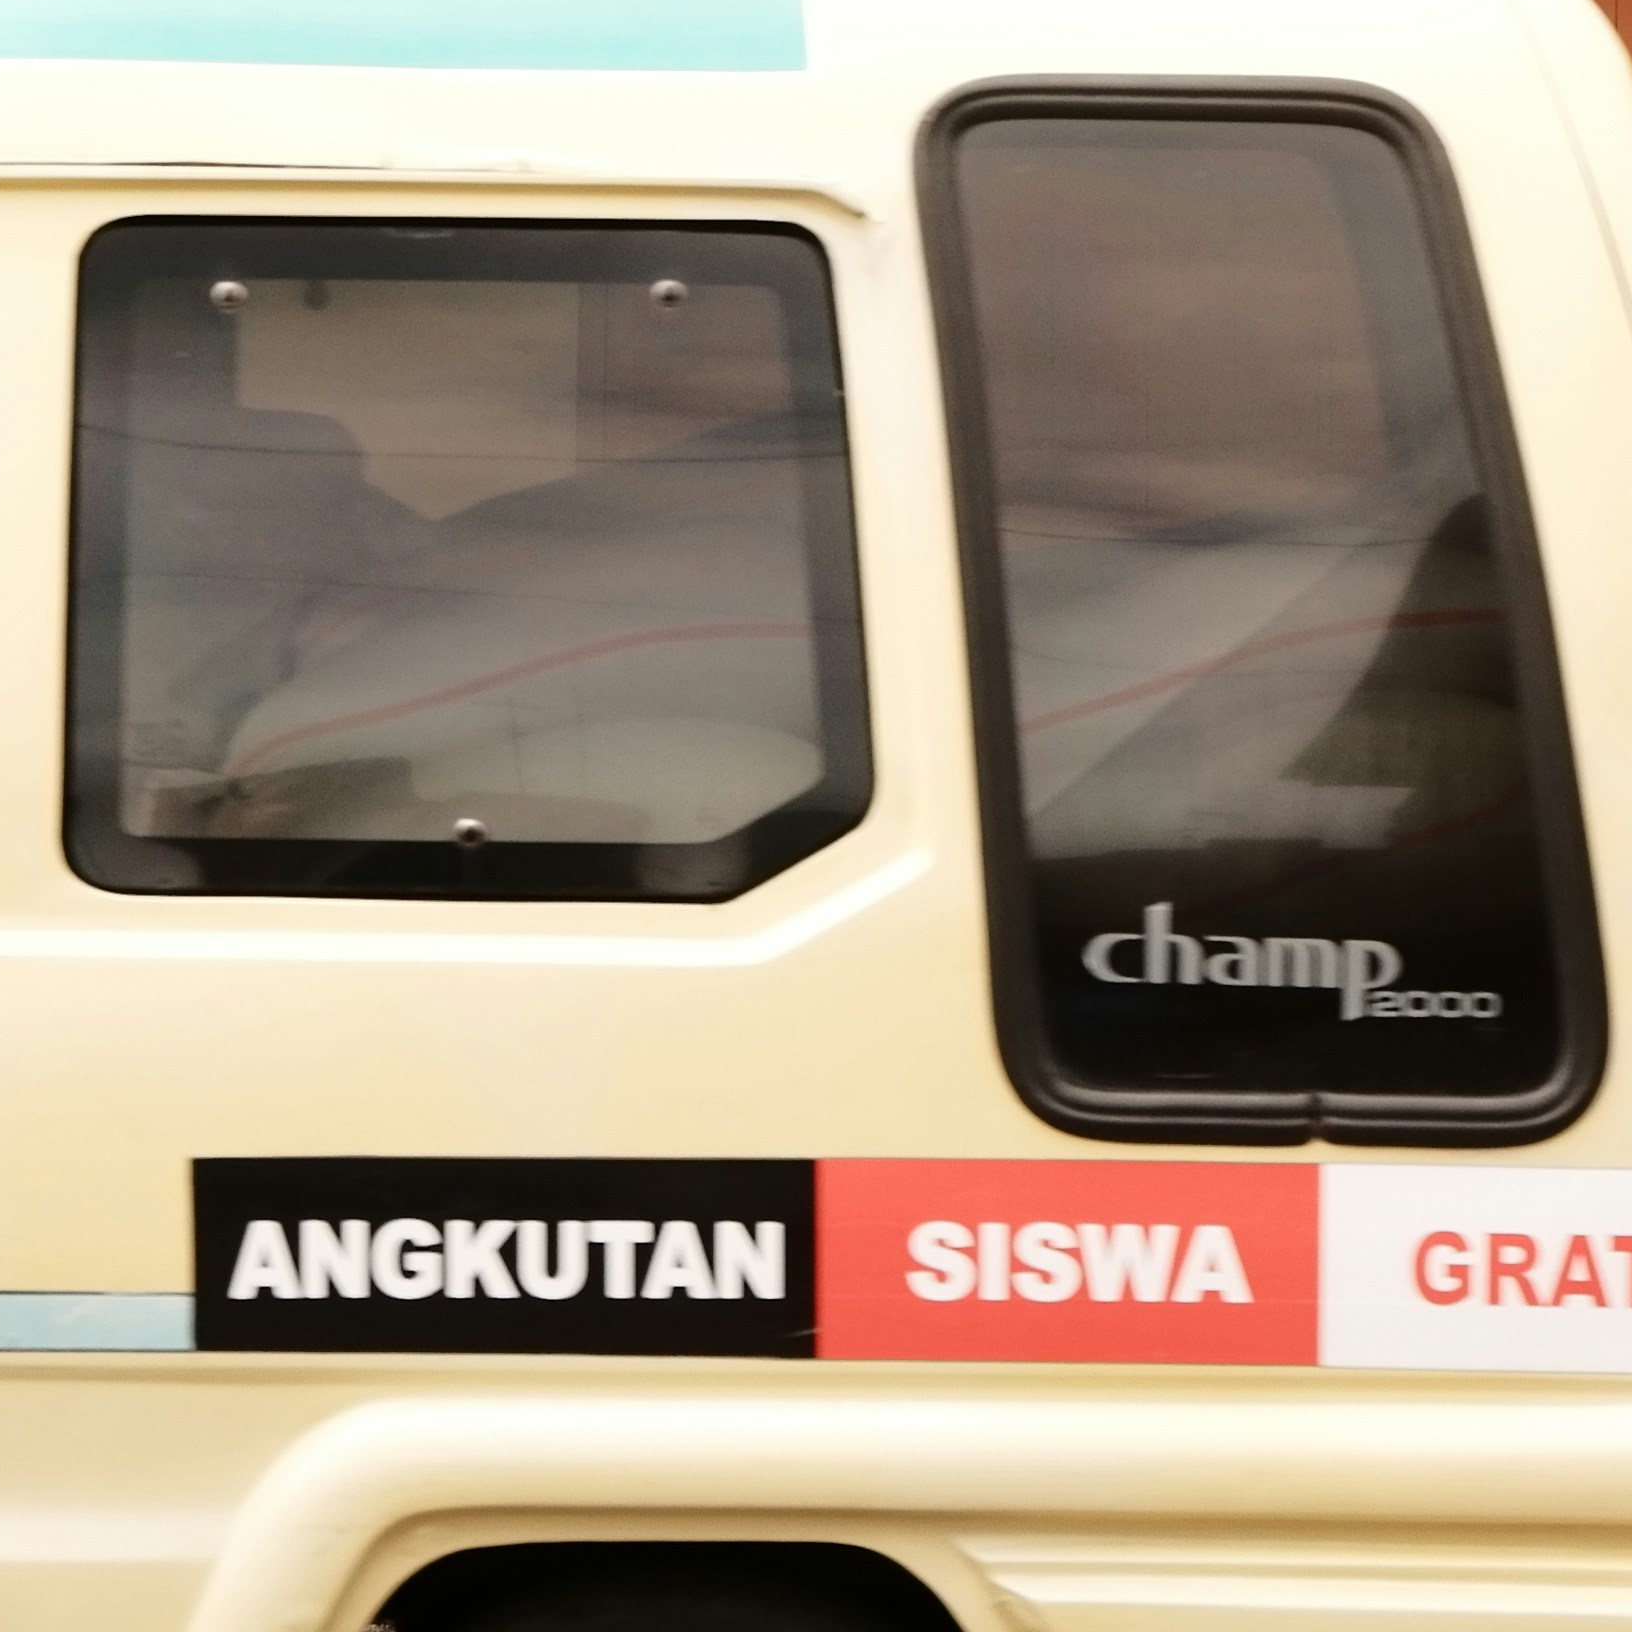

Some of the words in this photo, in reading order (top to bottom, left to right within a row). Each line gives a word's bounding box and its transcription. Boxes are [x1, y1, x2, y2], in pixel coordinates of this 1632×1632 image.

[1081, 901, 1403, 1020] champ
[1367, 990, 1502, 1018] 2000
[227, 1218, 786, 1299] ANGKUTAN
[905, 1220, 1255, 1303] SISWA
